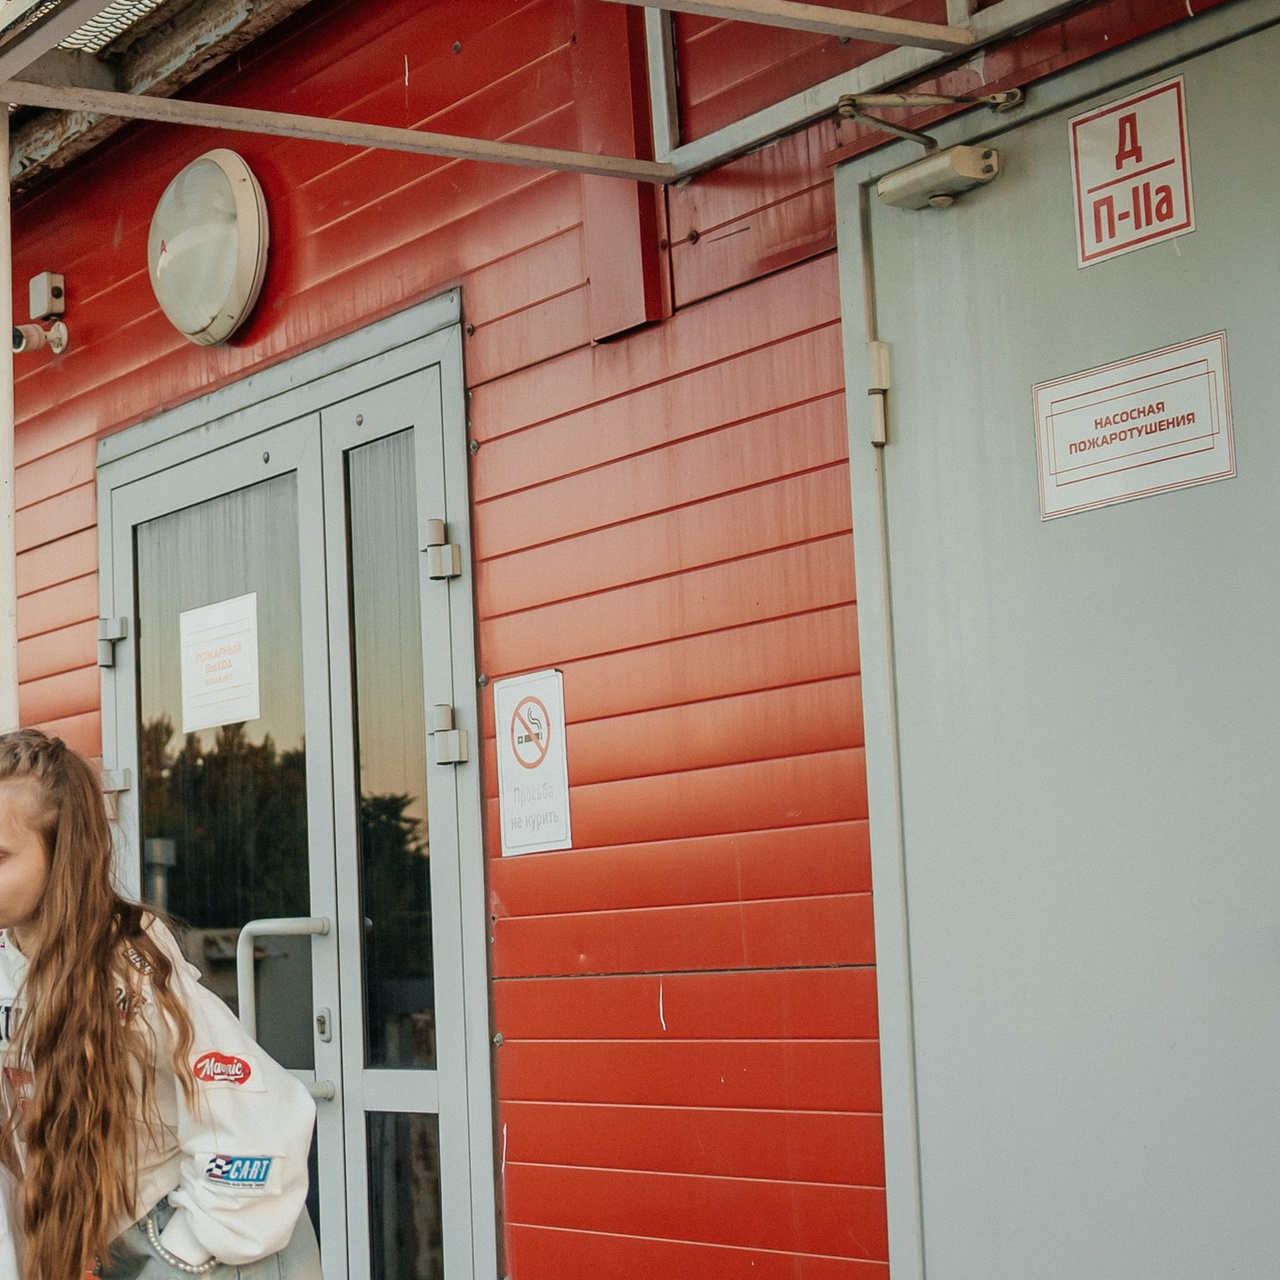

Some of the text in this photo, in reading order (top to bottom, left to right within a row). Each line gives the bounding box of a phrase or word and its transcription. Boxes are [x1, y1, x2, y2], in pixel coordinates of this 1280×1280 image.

[1115, 112, 1143, 171] Д
[1094, 401, 1166, 430] НАСОСНАЯ
[1069, 411, 1196, 455] ПОЖАРОТУШЕНИЯ
[514, 782, 554, 806] Просьба
[511, 811, 559, 831] не курить
[229, 1160, 270, 1179] CART
